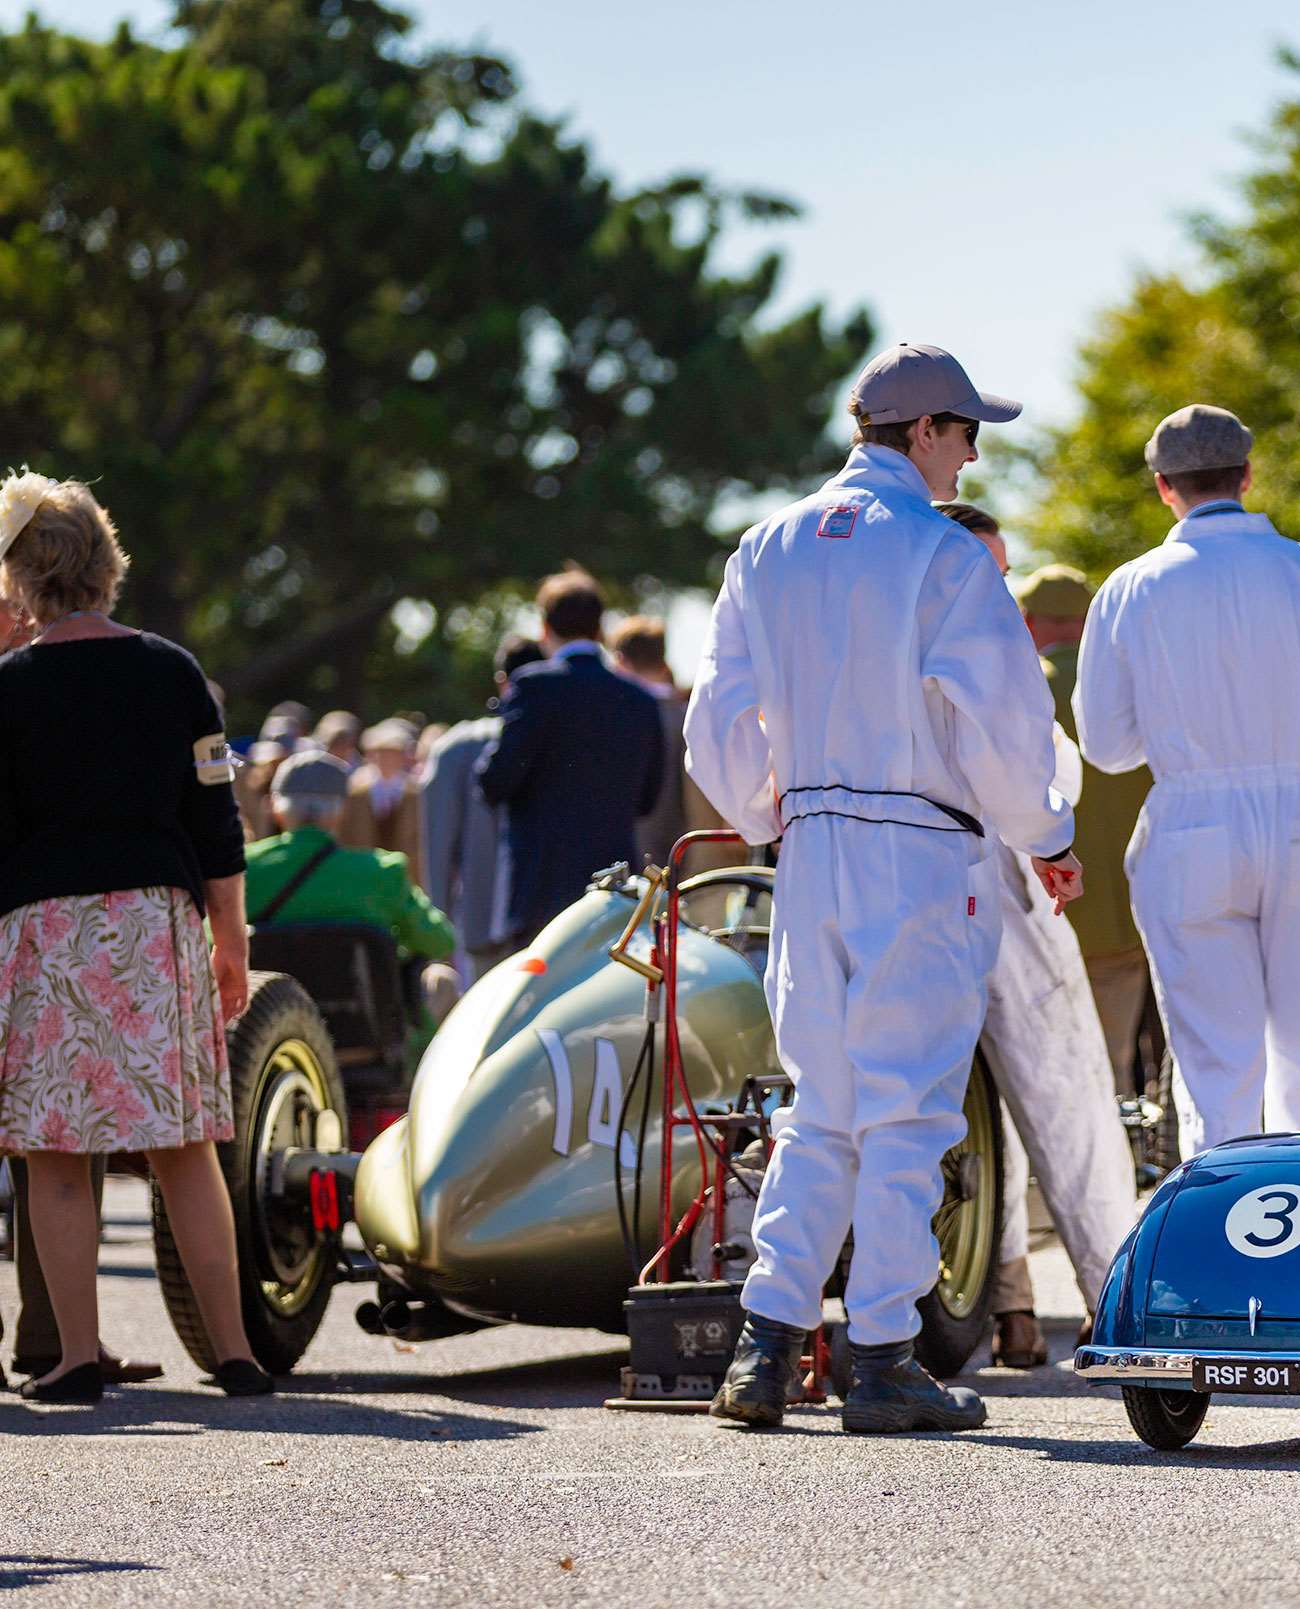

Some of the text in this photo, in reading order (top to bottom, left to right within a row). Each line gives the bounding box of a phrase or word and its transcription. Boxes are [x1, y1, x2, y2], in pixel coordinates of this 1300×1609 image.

[535, 1028, 638, 1169] 14
[1244, 1191, 1299, 1247] 3
[1205, 1365, 1289, 1386] RSF 301
